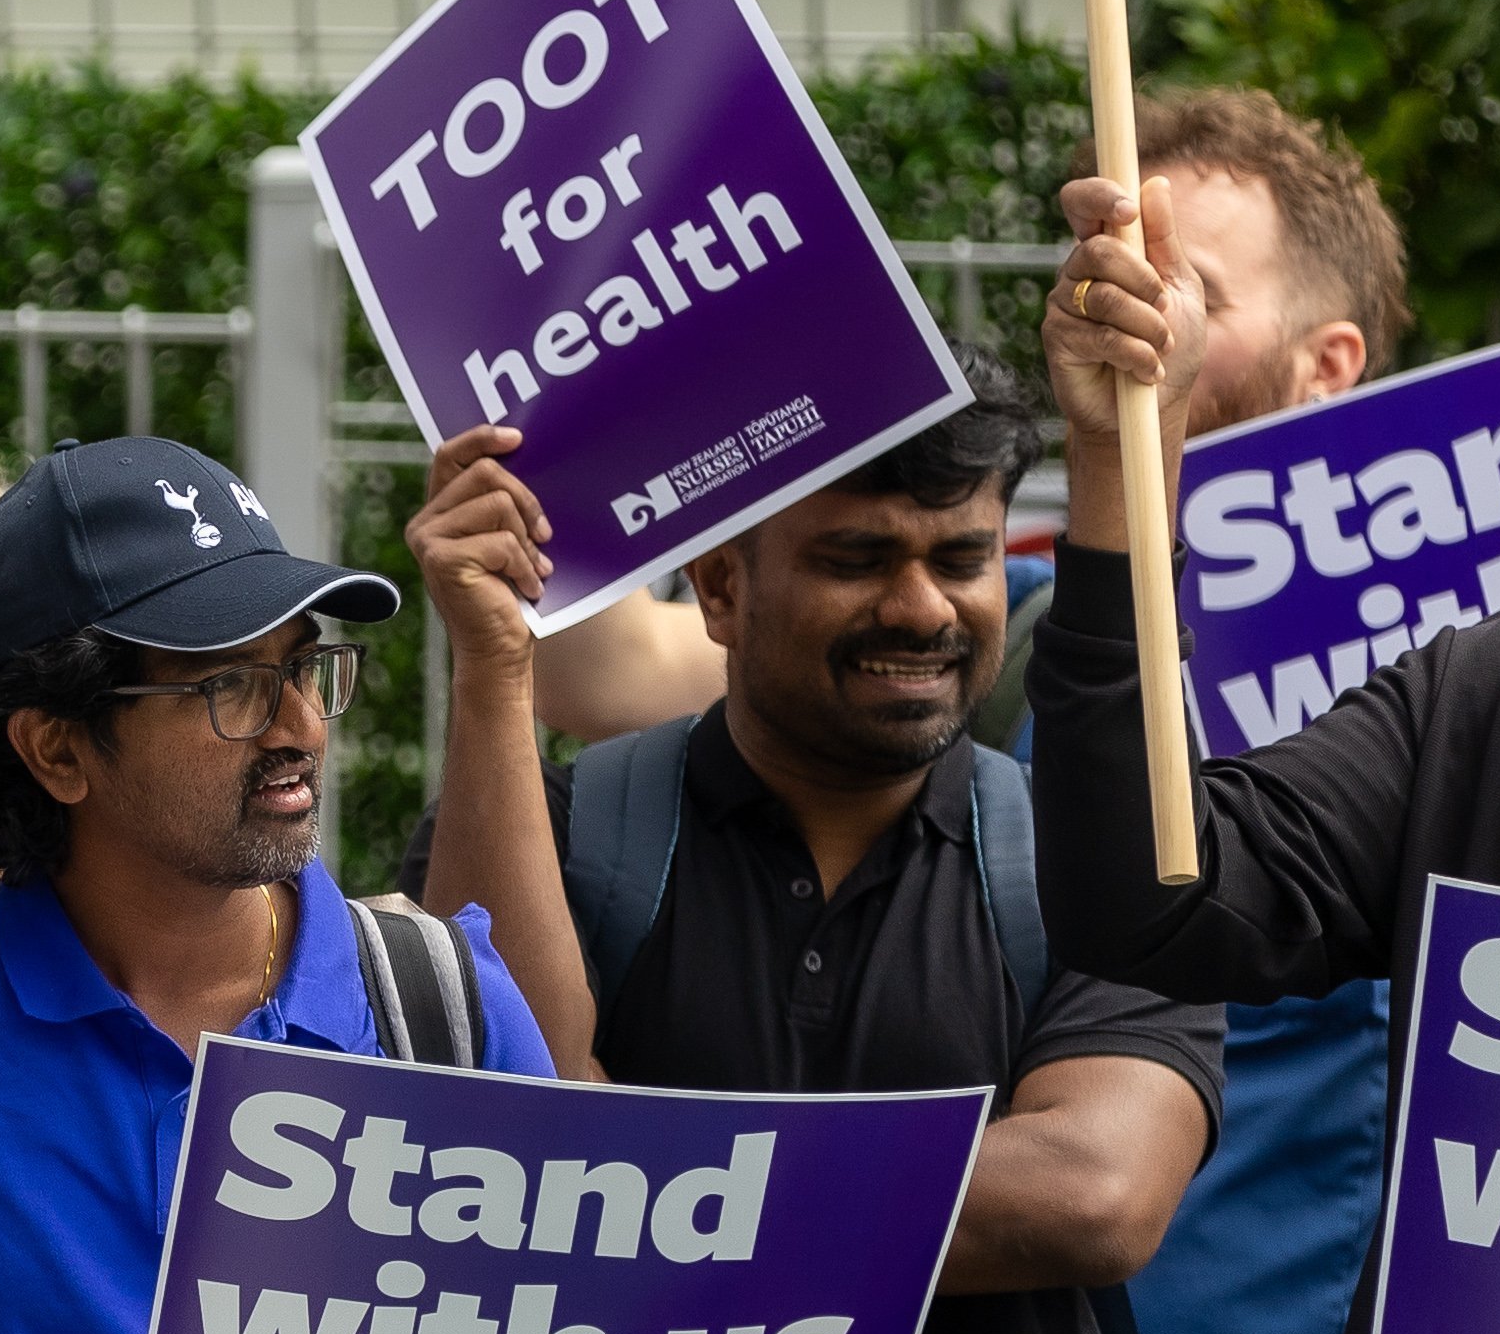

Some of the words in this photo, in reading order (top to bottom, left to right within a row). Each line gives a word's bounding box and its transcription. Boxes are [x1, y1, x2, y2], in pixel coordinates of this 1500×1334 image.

[500, 133, 644, 276] for
[463, 183, 804, 425] health
[667, 459, 691, 480] NEW
[693, 436, 736, 467] ZEALAND
[674, 446, 745, 494] NURSES
[750, 405, 822, 452] TAPUHI
[214, 1090, 778, 1264] Stand
